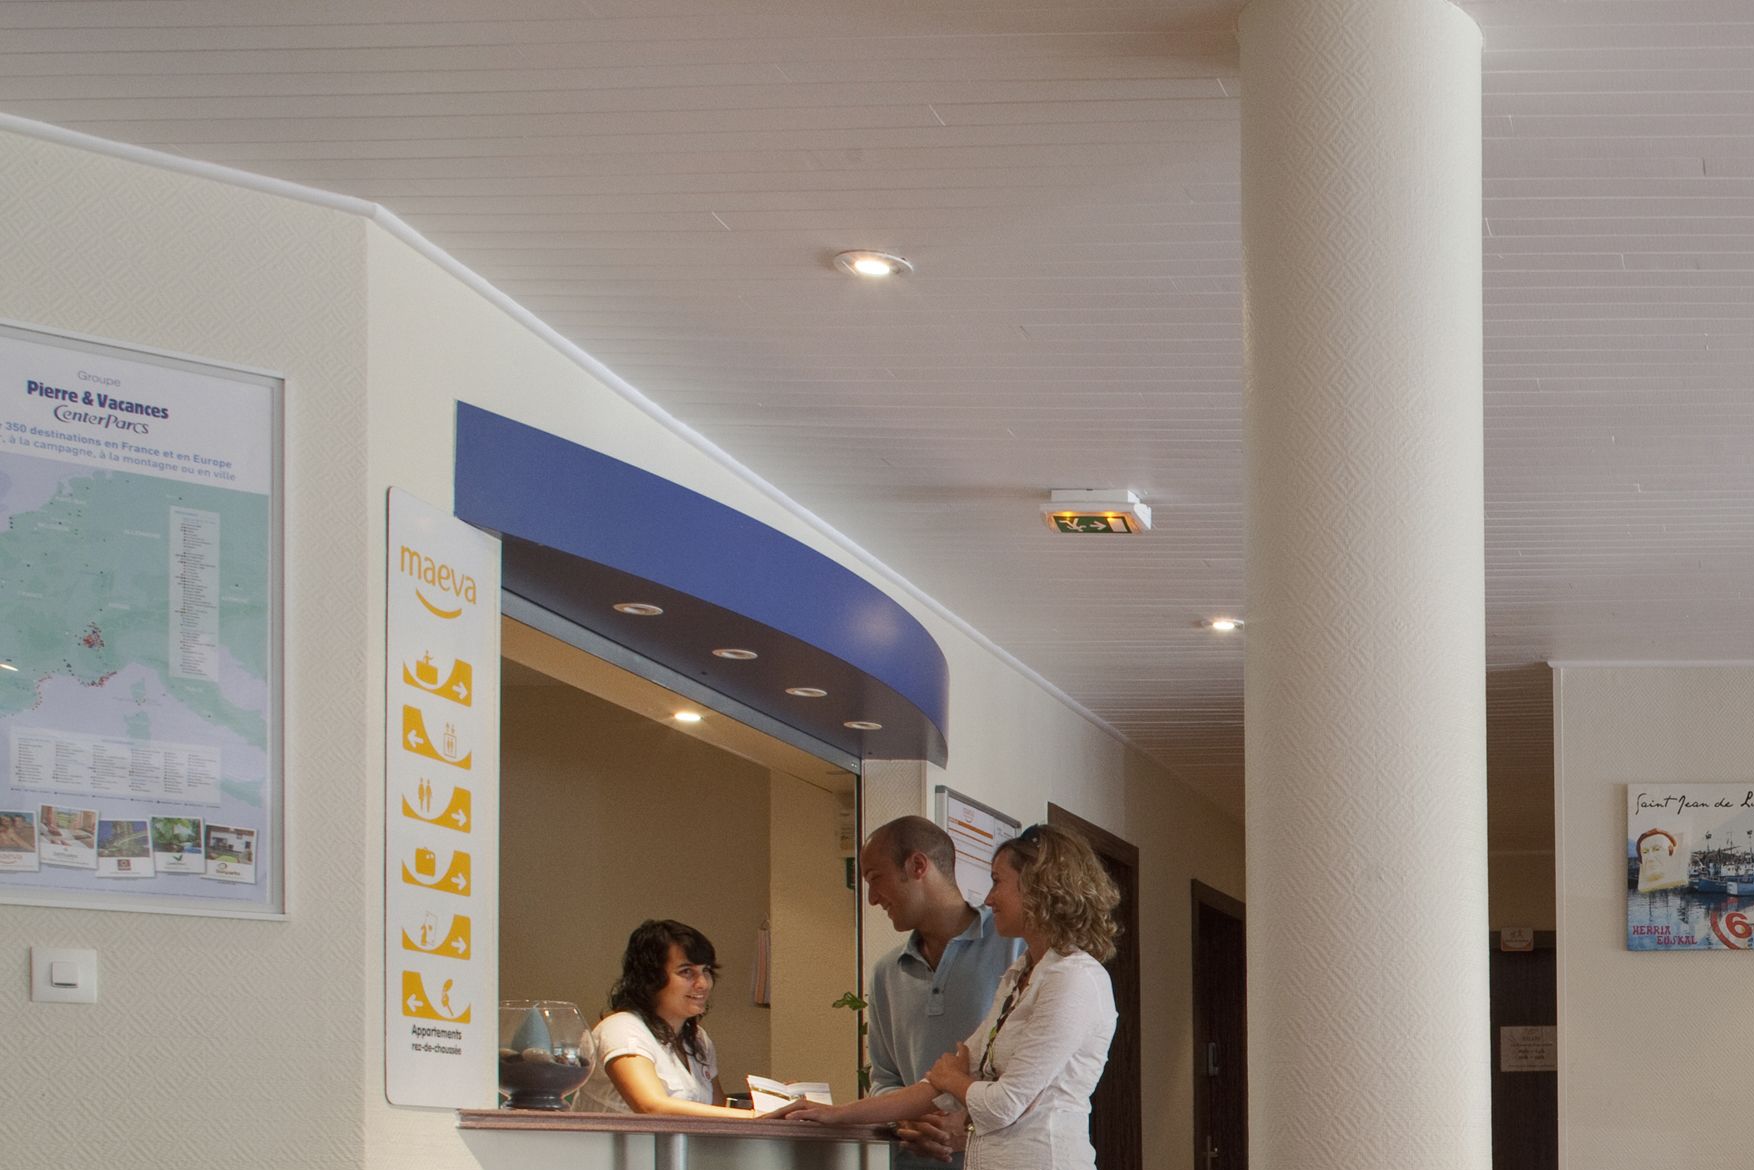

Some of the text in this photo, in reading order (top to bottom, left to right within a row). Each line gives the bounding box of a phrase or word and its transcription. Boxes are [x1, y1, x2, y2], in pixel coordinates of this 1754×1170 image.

[77, 370, 121, 388] Groupe
[26, 380, 169, 420] Pierre & Vacances
[5, 421, 27, 433] 350
[30, 425, 102, 447] destinations
[104, 440, 119, 450] en
[121, 441, 160, 457] France
[163, 449, 174, 459] et
[176, 452, 191, 462] en
[193, 454, 233, 470] Europe
[19, 437, 31, 447] la
[108, 451, 120, 462] la
[122, 454, 178, 474] montagne
[197, 467, 211, 477] en
[212, 469, 236, 481] ville
[400, 544, 477, 605] maeva
[1635, 792, 1677, 815] Saint
[1714, 797, 1733, 808] de
[1632, 925, 1671, 936] HERRIA
[1656, 935, 1698, 945] EUSKAL
[411, 1024, 463, 1040] Appartements
